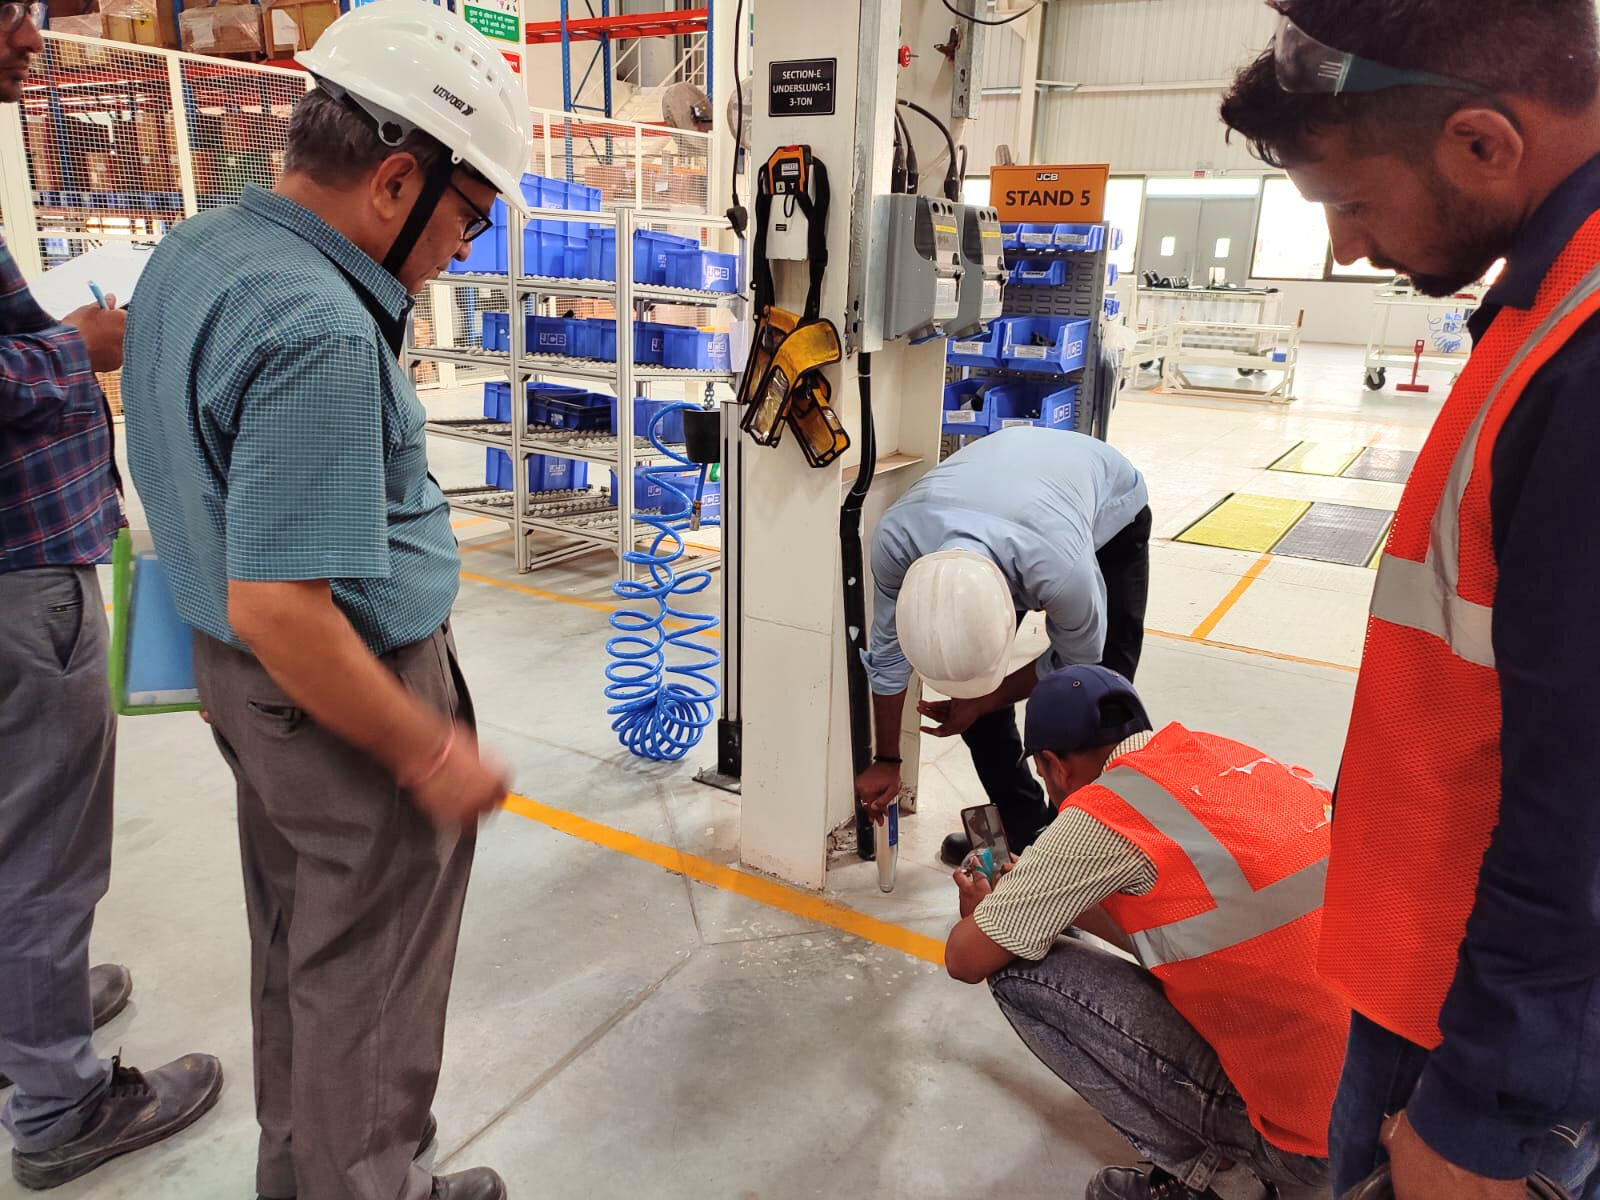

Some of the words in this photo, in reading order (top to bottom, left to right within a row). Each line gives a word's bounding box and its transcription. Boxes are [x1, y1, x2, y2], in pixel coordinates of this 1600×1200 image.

[782, 69, 822, 80] SECTION-E
[772, 82, 831, 93] UNDERSLUNG-1
[789, 97, 813, 107] 3-TON
[1036, 173, 1059, 181] JCB
[1005, 190, 1074, 206] STAND
[1080, 190, 1090, 206] 5
[707, 266, 729, 280] JCB
[540, 333, 567, 346] JCB
[1055, 404, 1071, 423] JCB
